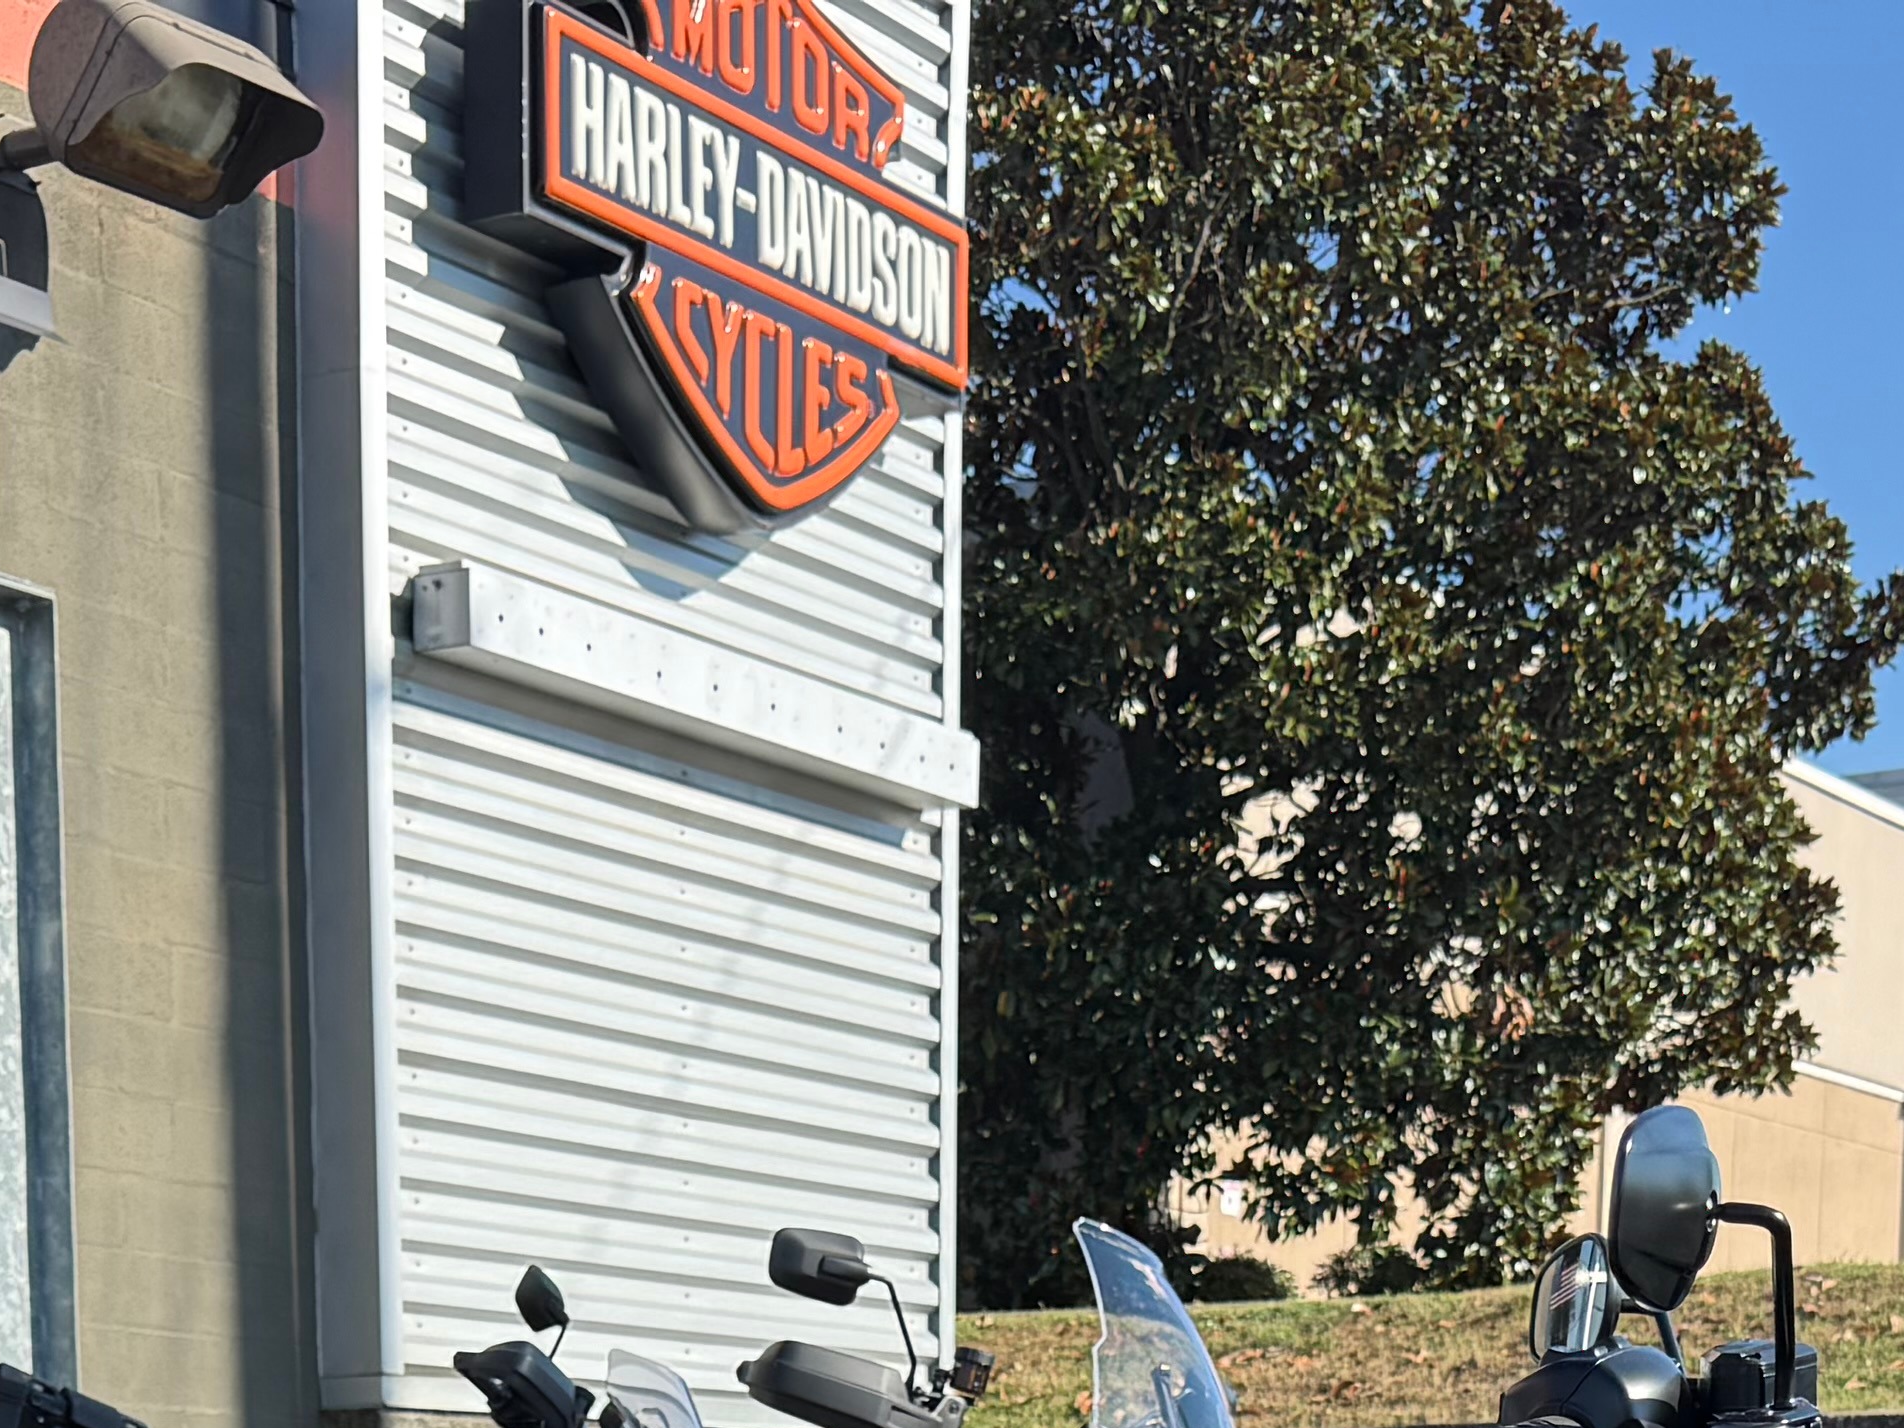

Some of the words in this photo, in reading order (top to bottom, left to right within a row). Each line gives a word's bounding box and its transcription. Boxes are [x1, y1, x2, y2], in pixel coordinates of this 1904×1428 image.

[670, 0, 871, 163] MOTOR
[569, 52, 952, 357] HARLEY-DAVIDSON
[672, 277, 867, 477] CYCLES
